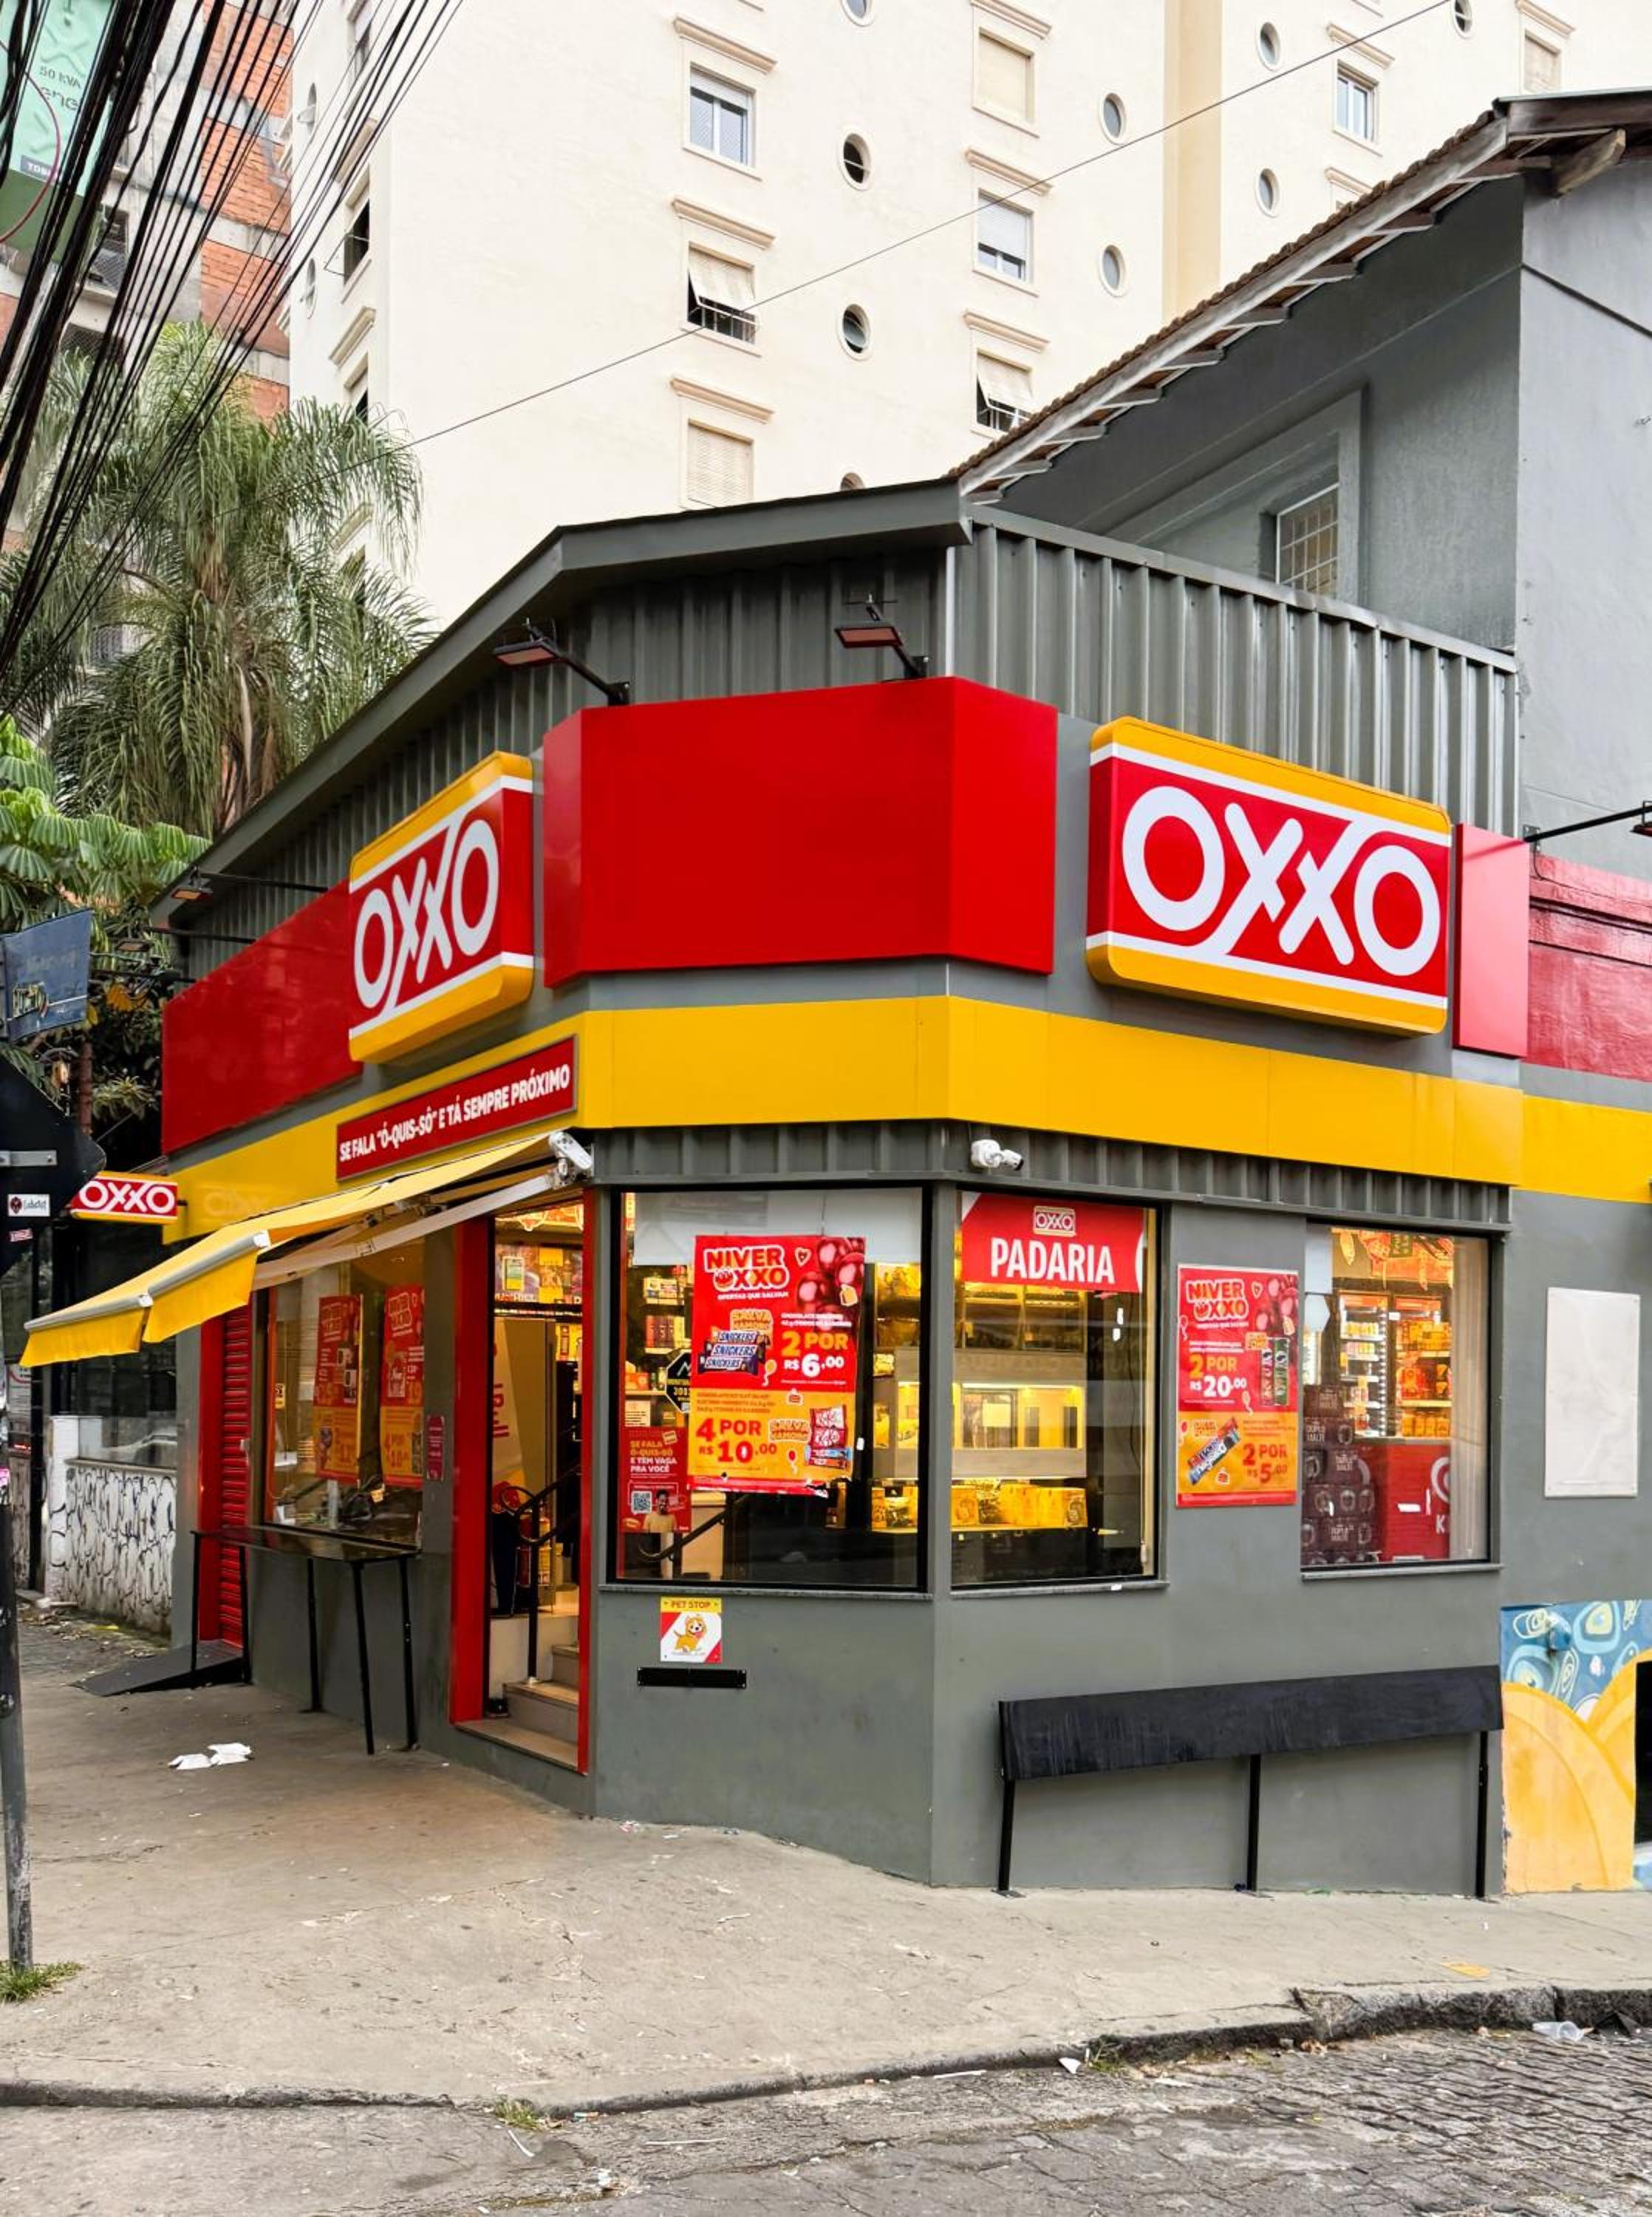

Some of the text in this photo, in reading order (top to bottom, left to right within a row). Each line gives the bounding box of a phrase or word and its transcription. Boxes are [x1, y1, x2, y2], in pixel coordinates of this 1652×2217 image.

[1122, 786, 1441, 976] OXXO
[354, 819, 499, 1015] OXXO
[340, 1140, 352, 1162] SE
[352, 1135, 376, 1158] FALA
[439, 1108, 446, 1129] E
[446, 1094, 463, 1126] TÁ
[463, 1085, 510, 1121] SEMPRE
[511, 1064, 570, 1106] PRÓXIMO
[78, 1180, 176, 1213] OXXO
[1035, 1212, 1074, 1230] OXXO
[706, 1247, 783, 1271] NIVER
[991, 1236, 1116, 1284] PADARIA
[714, 1267, 788, 1290] OXXO
[1187, 1281, 1243, 1300] NIVER
[782, 1331, 849, 1358] 2 POR
[784, 1359, 800, 1371] R$
[1189, 1354, 1238, 1379] 2 POR
[1190, 1381, 1202, 1391] R$
[695, 1417, 717, 1443] 4
[720, 1419, 762, 1436] POR
[698, 1445, 714, 1456] R$
[1243, 1443, 1256, 1466] 2
[1259, 1444, 1287, 1459] POR
[689, 1601, 711, 1610] STOP
